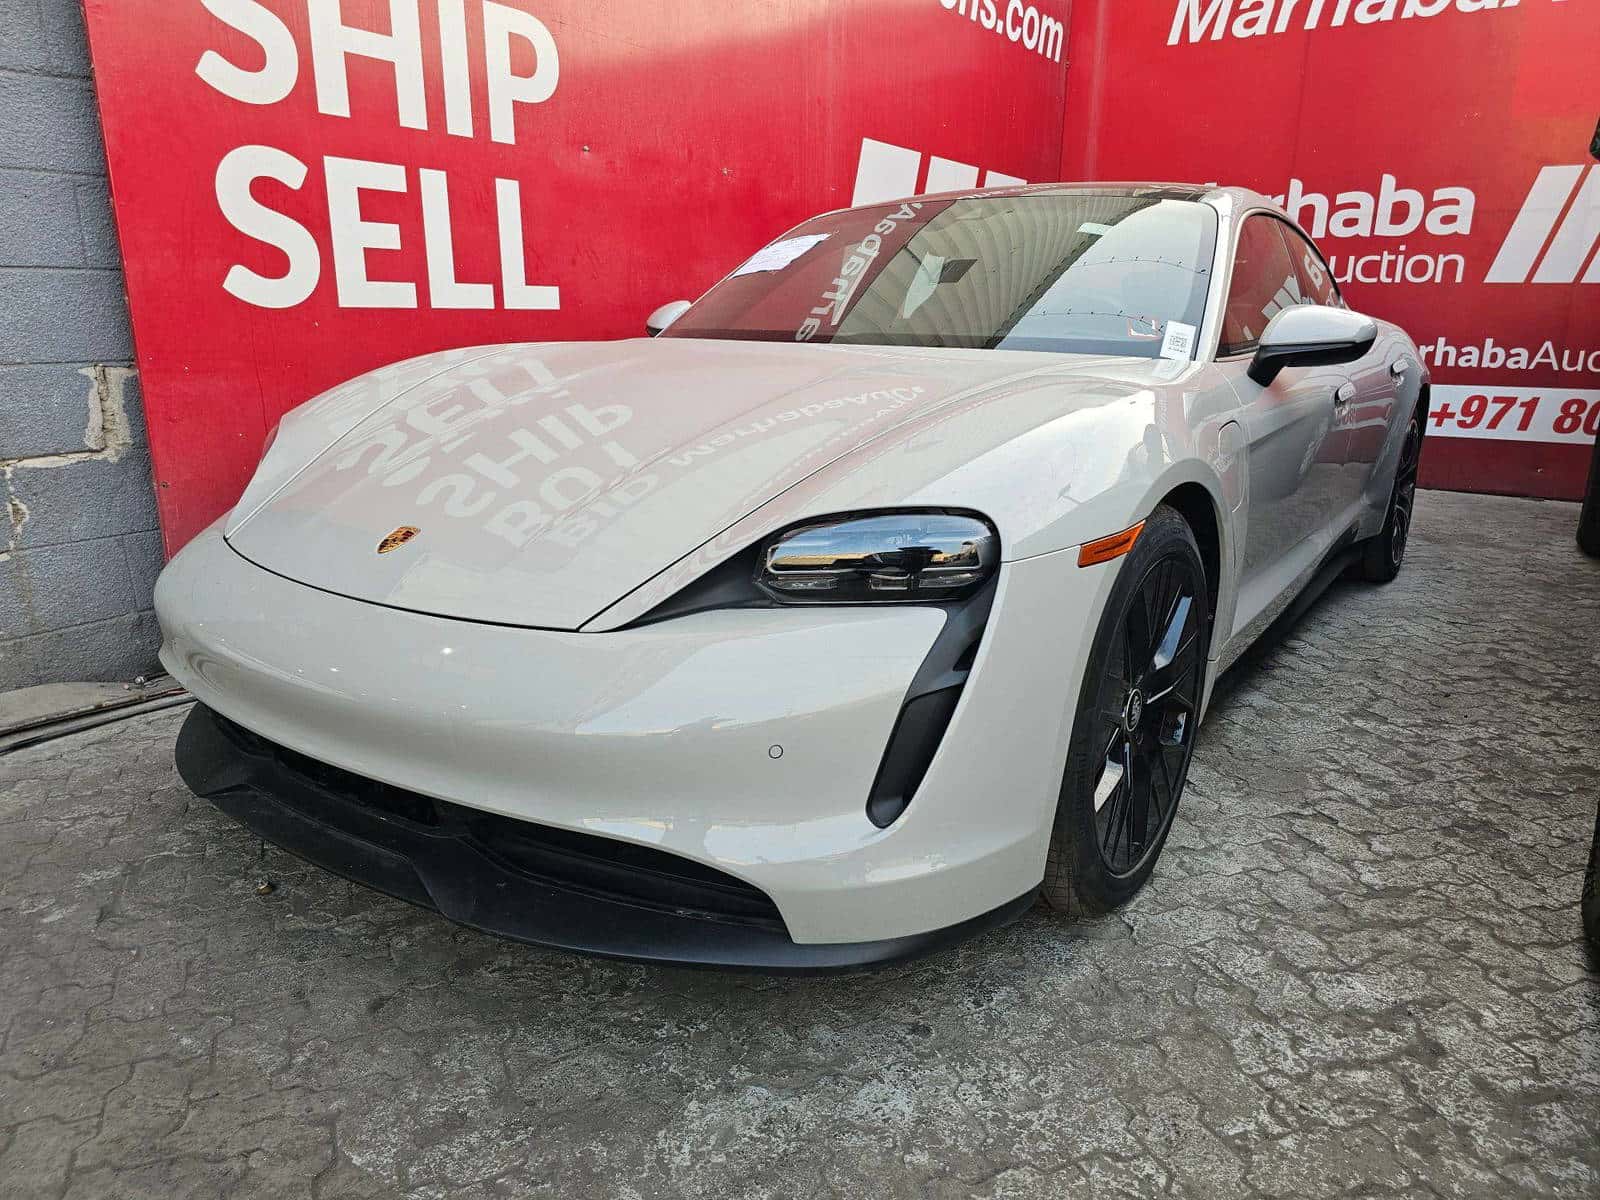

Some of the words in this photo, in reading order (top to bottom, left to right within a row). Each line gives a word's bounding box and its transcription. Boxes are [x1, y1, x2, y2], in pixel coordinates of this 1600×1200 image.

[195, 0, 560, 145] SHIP
[214, 144, 561, 309] SELL
[1328, 244, 1466, 284] uction
[1428, 394, 1542, 433] +971
